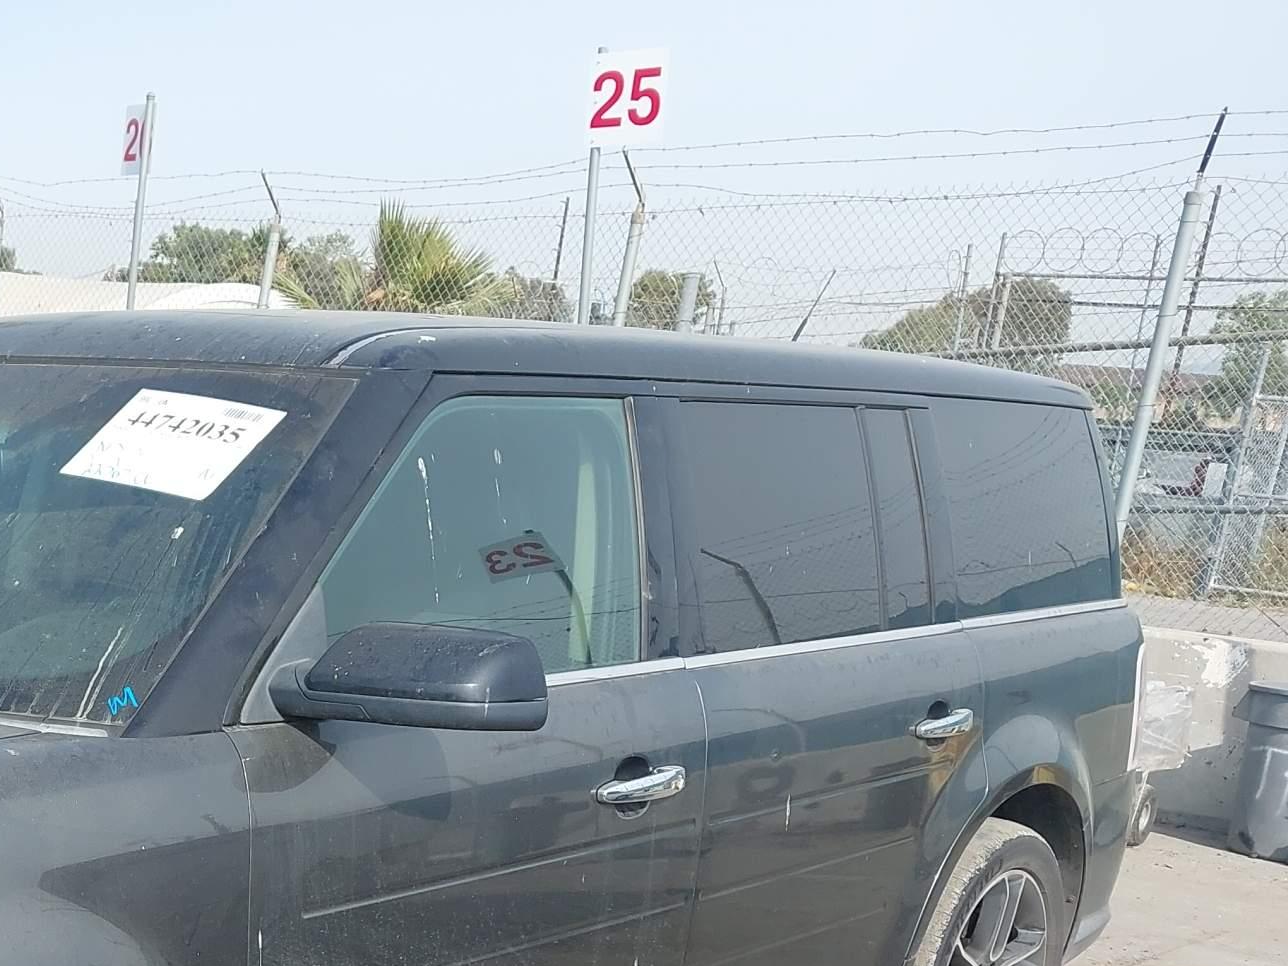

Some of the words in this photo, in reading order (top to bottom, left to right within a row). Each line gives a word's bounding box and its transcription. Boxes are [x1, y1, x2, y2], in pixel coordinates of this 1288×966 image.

[590, 66, 662, 128] 25
[123, 117, 145, 162] 2
[127, 411, 247, 444] 44742035
